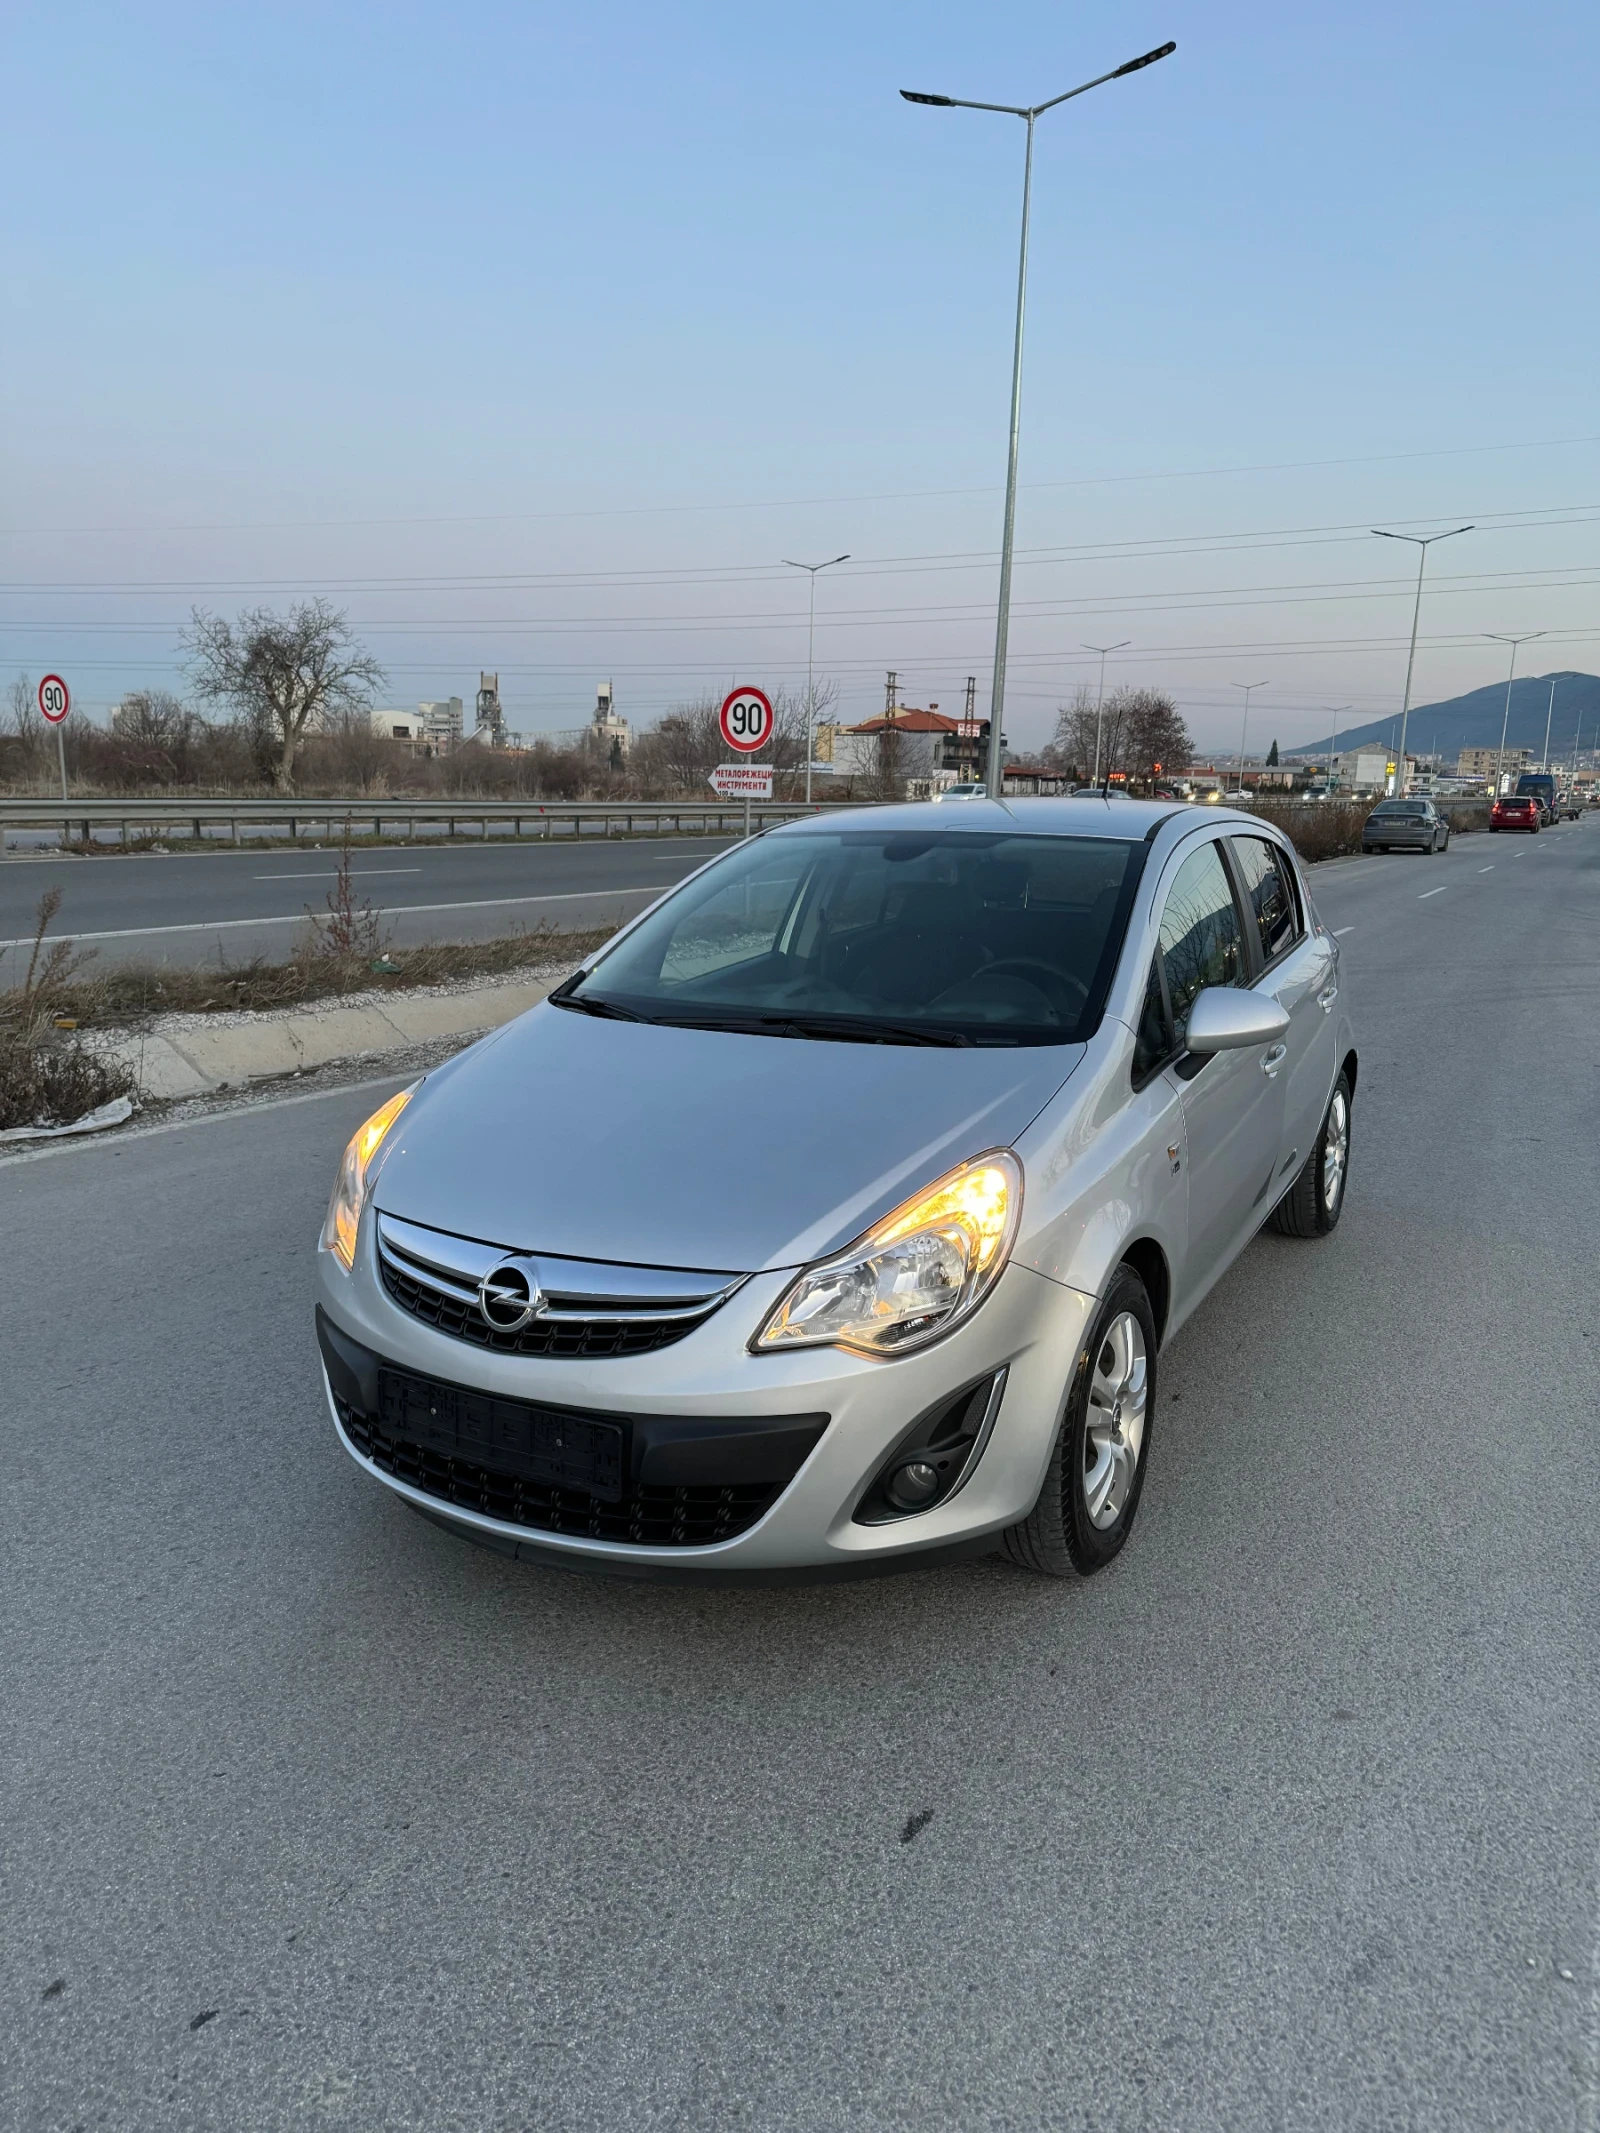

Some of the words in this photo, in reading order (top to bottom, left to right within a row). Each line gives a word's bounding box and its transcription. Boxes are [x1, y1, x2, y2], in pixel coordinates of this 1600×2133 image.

[45, 687, 63, 711] 90
[732, 702, 762, 735] 90
[715, 769, 773, 780] МЕТАЛОРЕЖЕЩИ
[717, 781, 767, 790] ИНСТРУМЕНТИ
